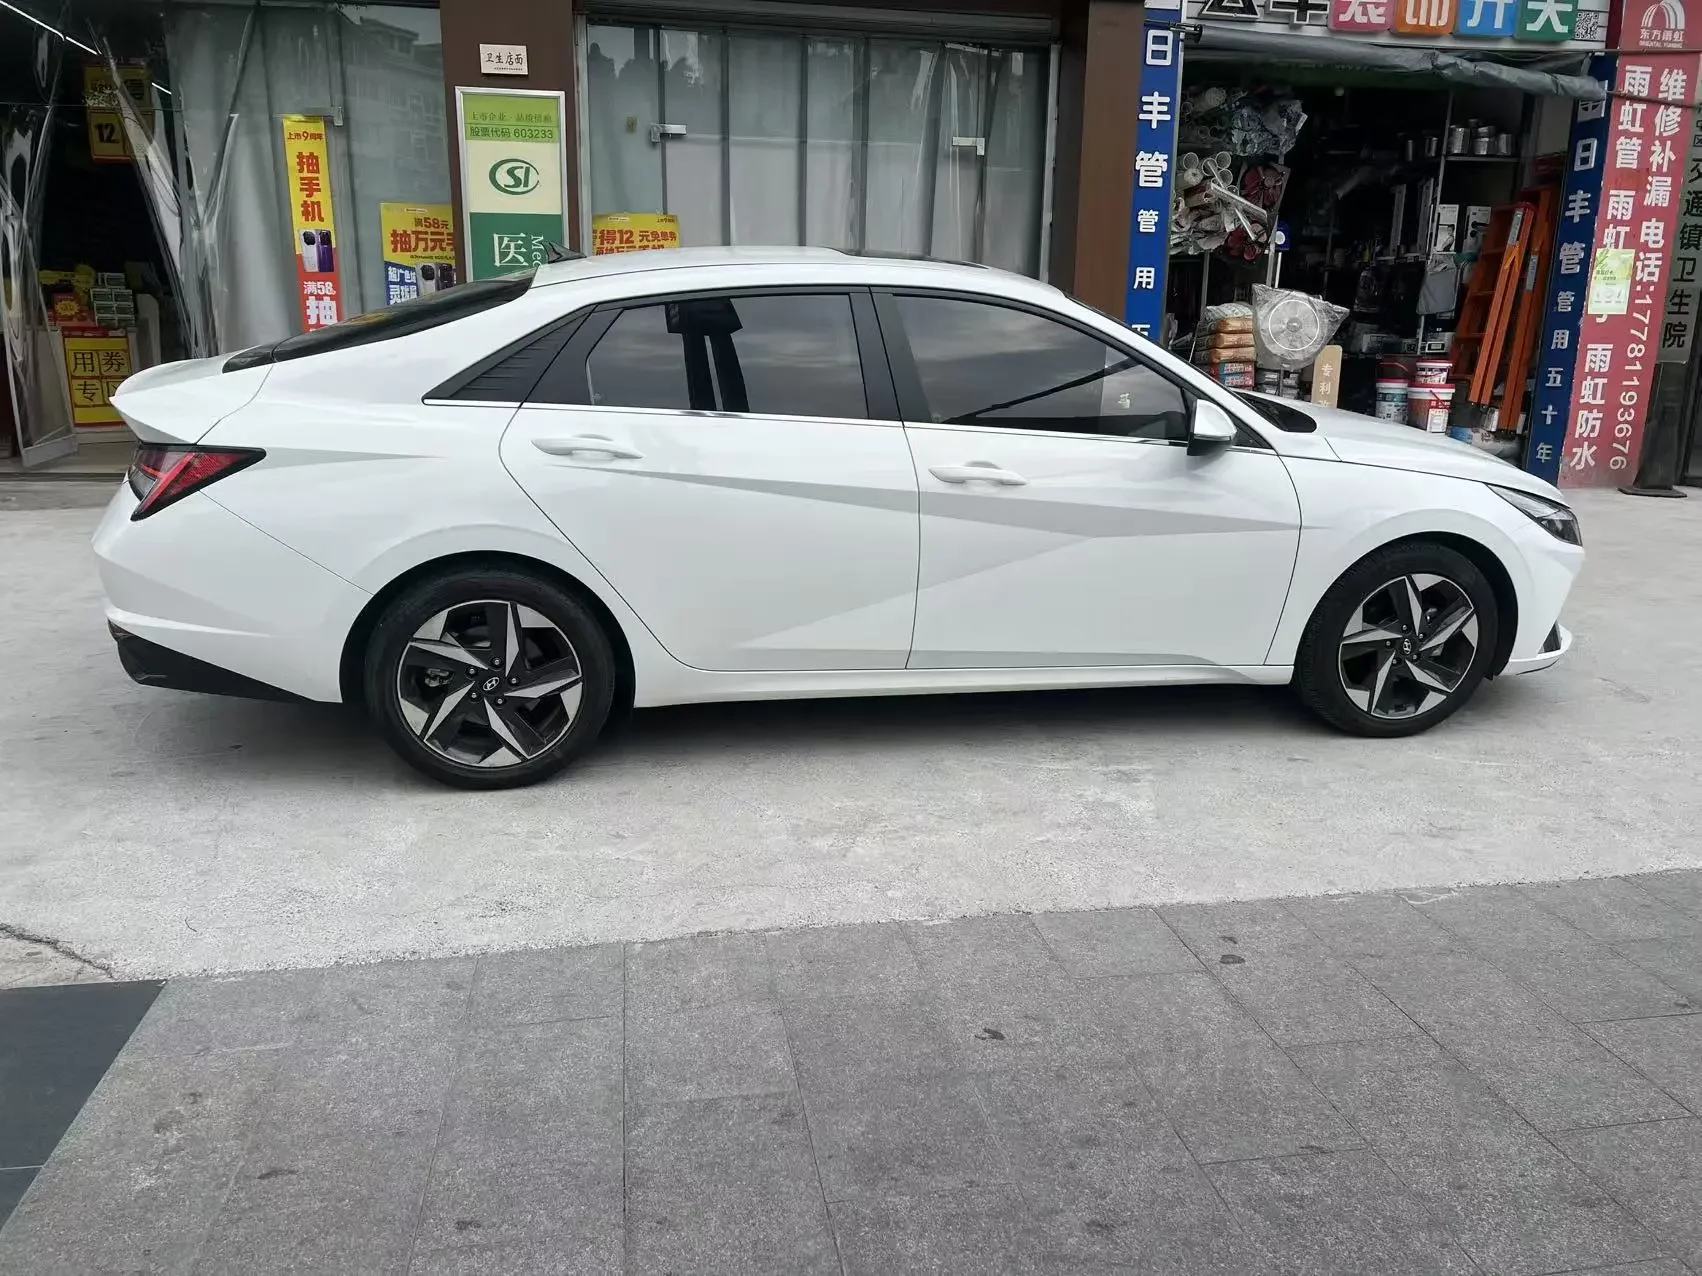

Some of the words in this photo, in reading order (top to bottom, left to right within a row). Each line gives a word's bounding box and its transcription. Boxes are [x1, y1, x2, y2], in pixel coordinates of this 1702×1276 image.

[486, 52, 523, 66] 卫生店面
[97, 122, 120, 144] 12
[513, 128, 553, 139] 603233
[1616, 65, 1652, 169] 雨虹管
[1643, 68, 1687, 207] 维修补漏
[296, 151, 325, 223] 抽手机
[493, 232, 528, 267] 医
[1570, 344, 1614, 470] 雨虹防水
